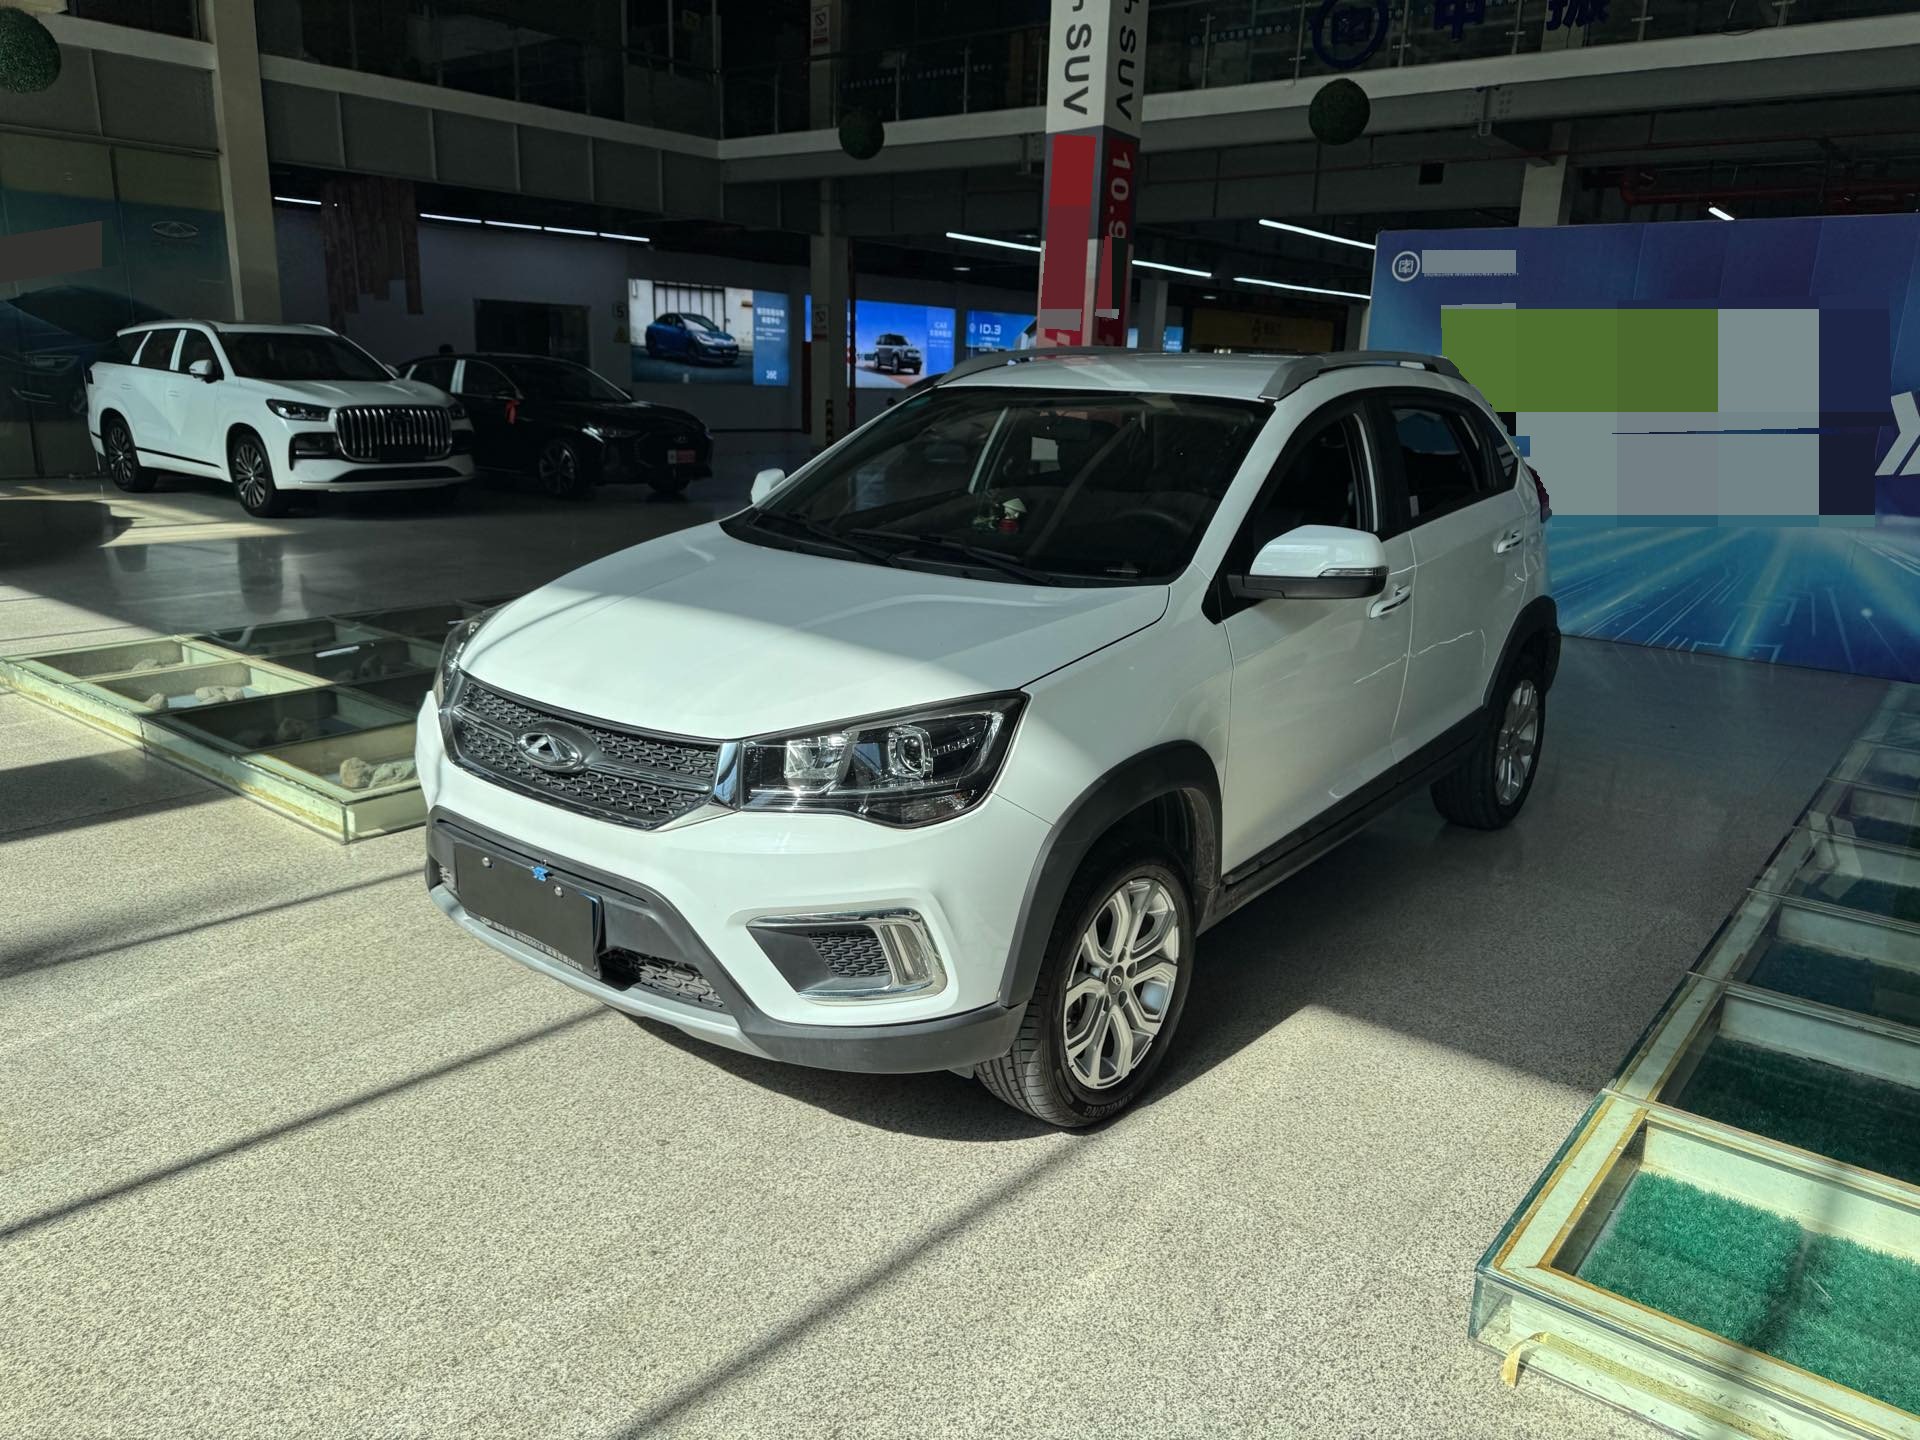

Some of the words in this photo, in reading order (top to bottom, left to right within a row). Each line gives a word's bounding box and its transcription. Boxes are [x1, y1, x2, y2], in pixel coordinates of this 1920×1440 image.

[1063, 23, 1092, 116] SUV
[1116, 25, 1136, 121] SUV
[979, 322, 1002, 336] ID.3
